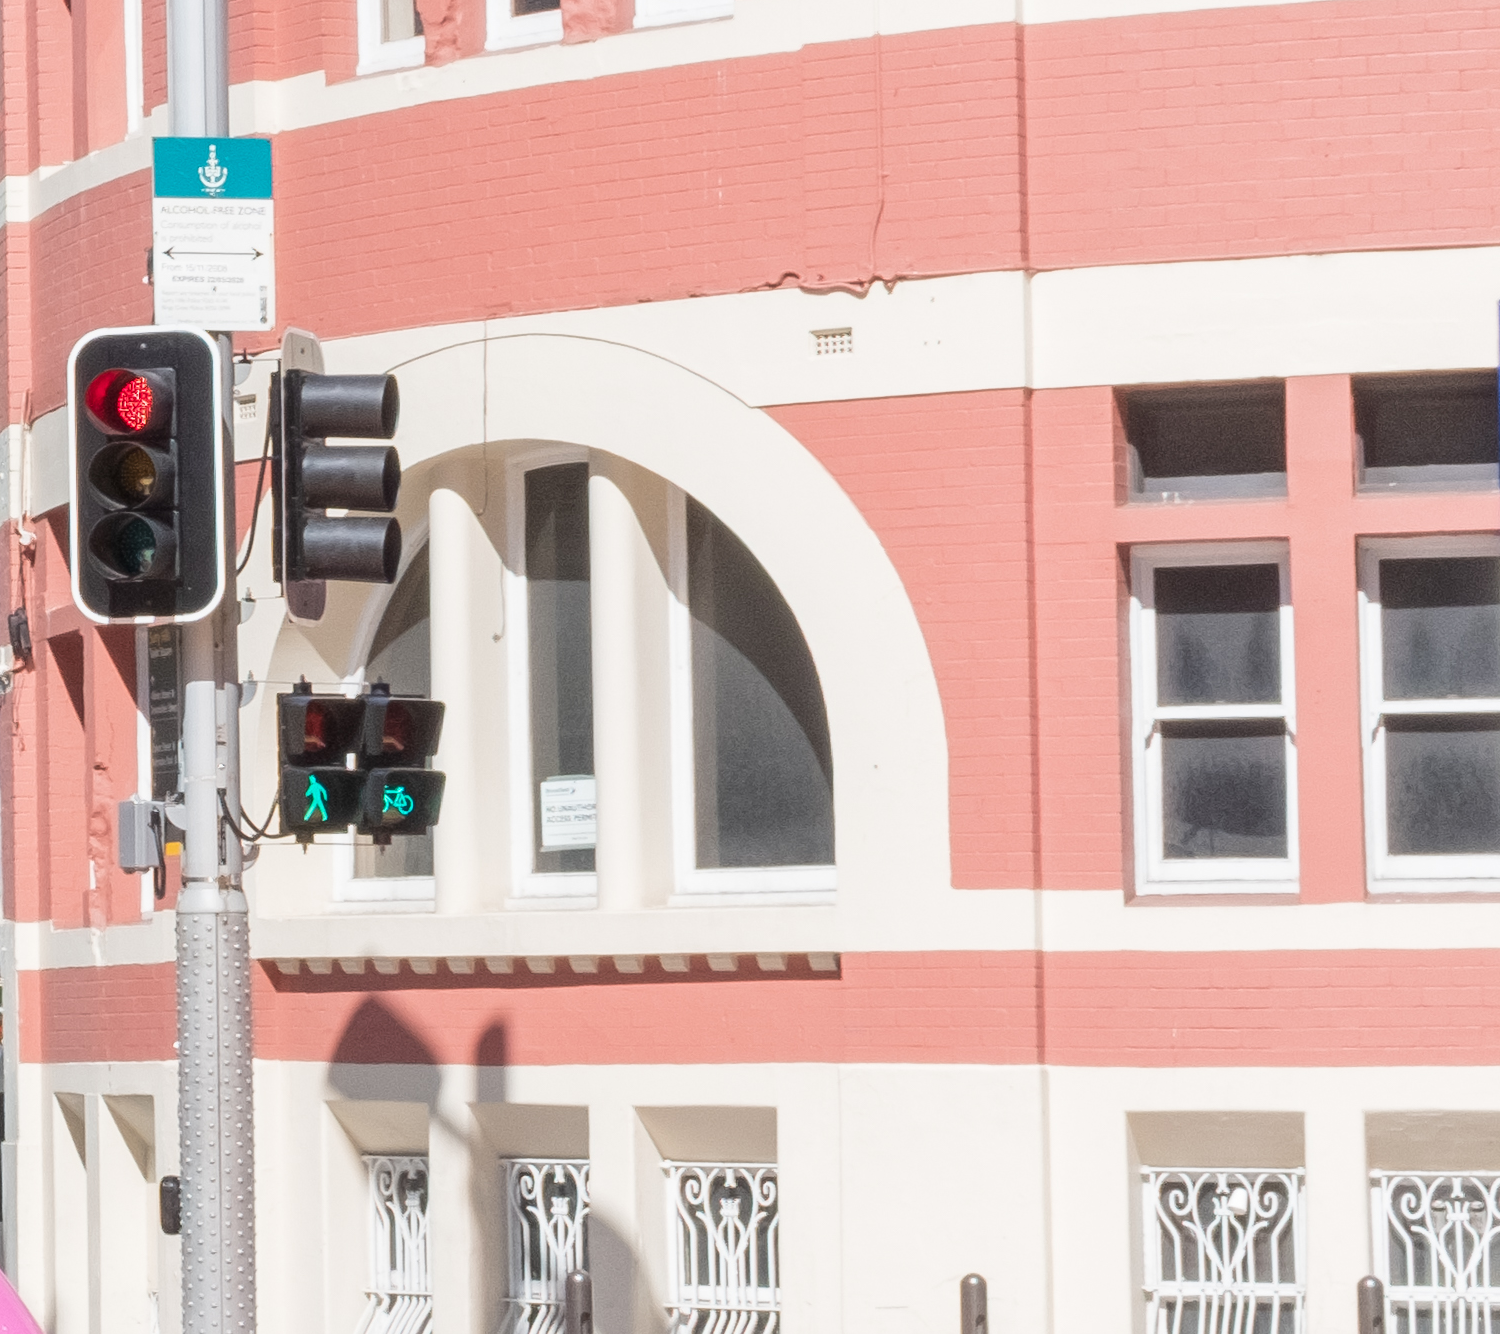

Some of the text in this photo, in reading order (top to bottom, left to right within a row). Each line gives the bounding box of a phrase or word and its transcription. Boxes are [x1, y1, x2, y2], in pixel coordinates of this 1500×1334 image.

[238, 206, 267, 216] ZONE
[160, 220, 263, 232] Consumption of alcohol
[169, 234, 214, 244] prohibited
